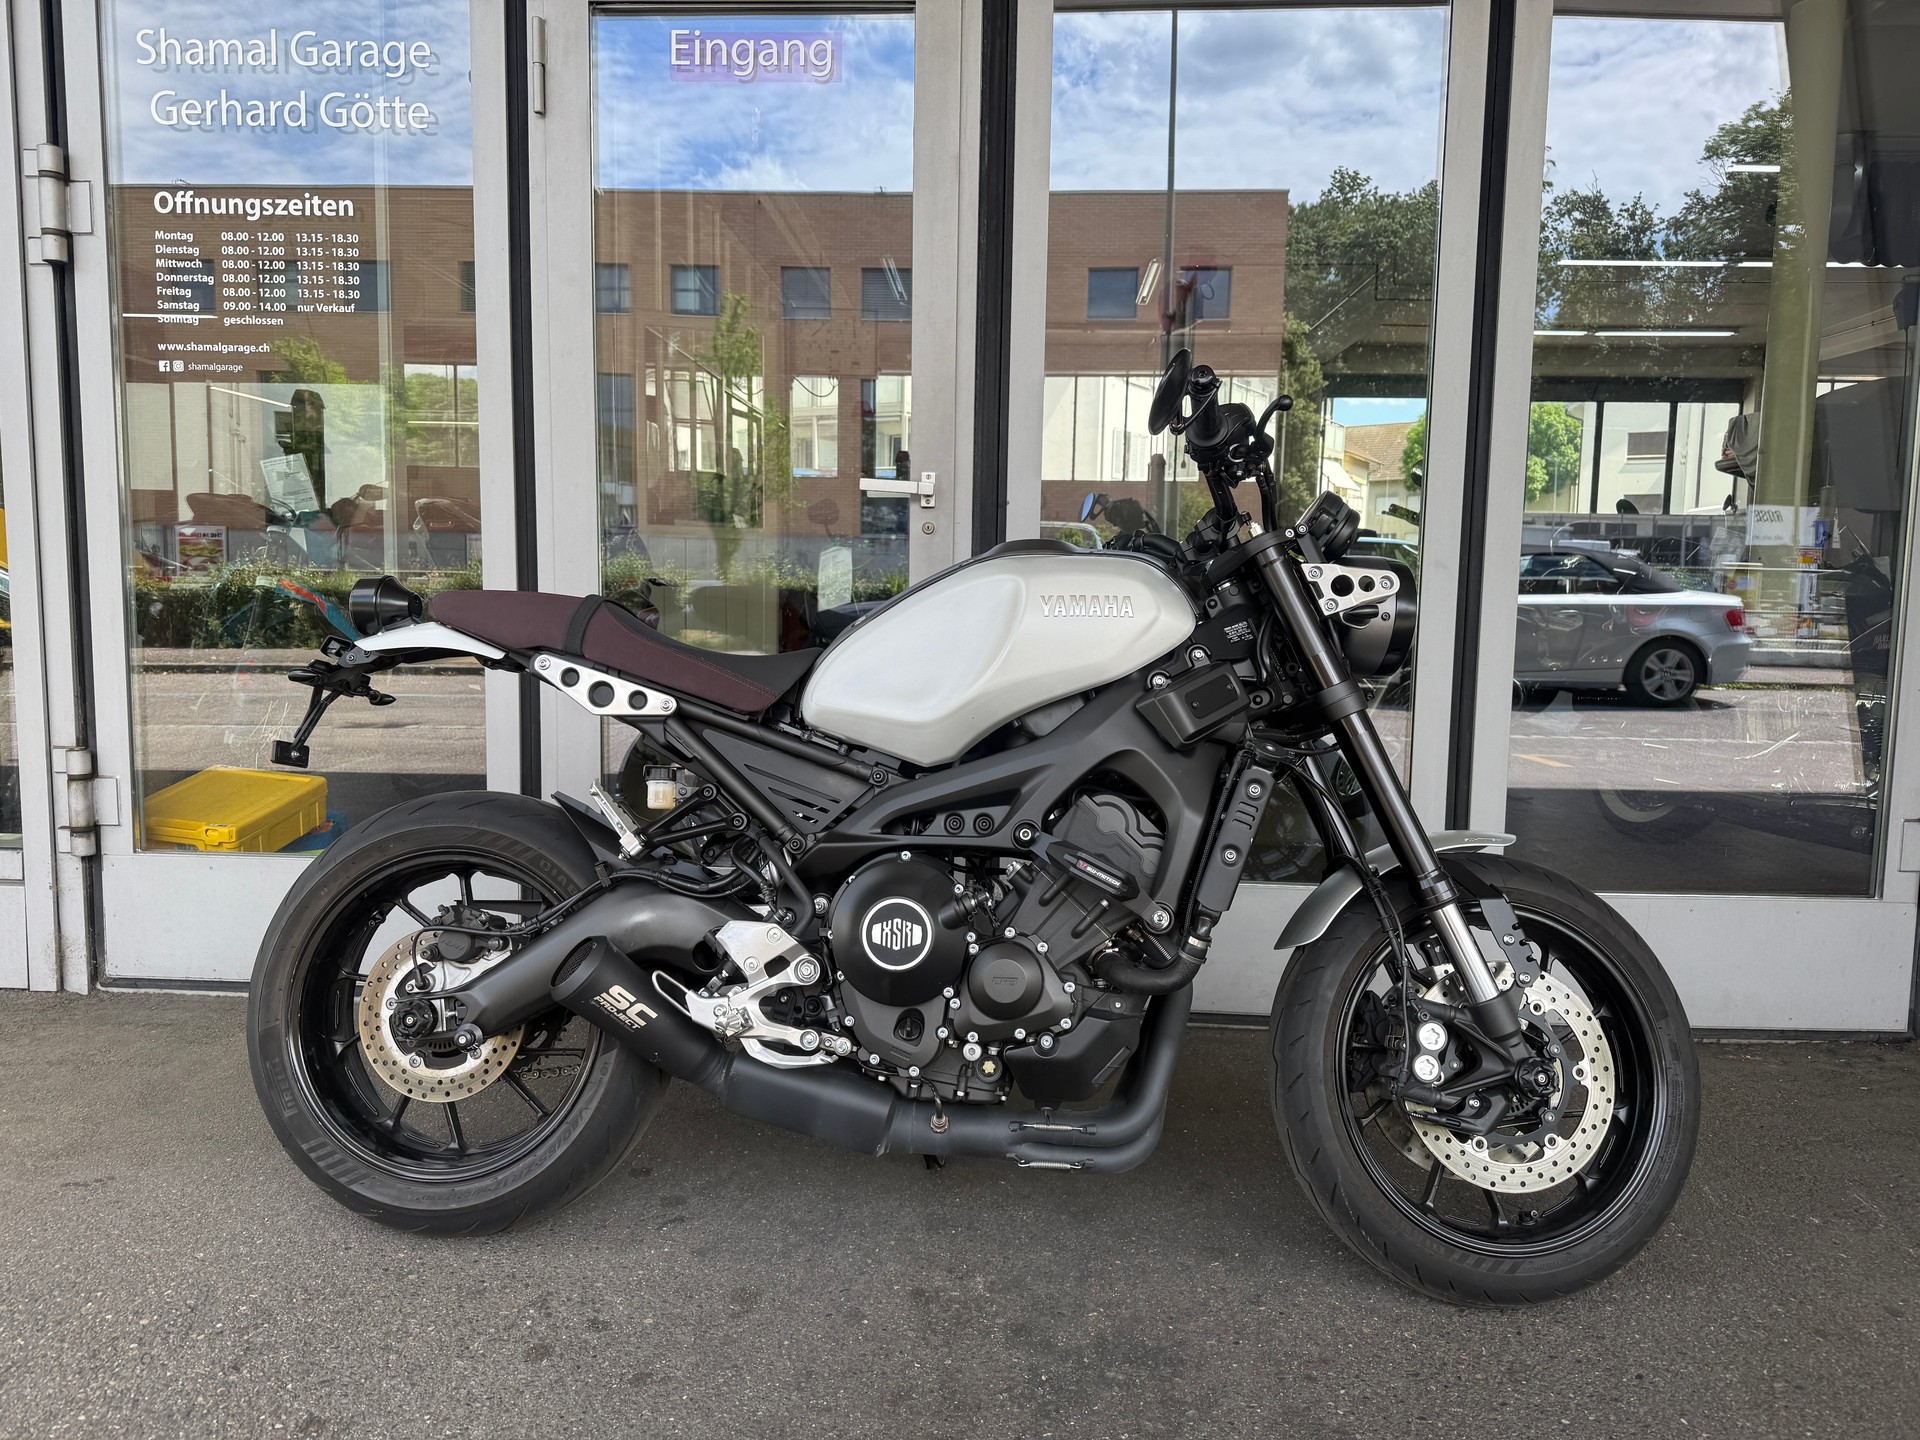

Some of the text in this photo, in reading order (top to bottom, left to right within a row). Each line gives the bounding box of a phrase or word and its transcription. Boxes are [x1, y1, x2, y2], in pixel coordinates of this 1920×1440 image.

[136, 28, 431, 78] Shamal Garage
[670, 29, 833, 77] Eingang
[150, 89, 430, 129] Gerhard Götte
[155, 231, 194, 243] Montag
[220, 232, 249, 242] 08.00
[257, 232, 285, 242] 12.00
[296, 233, 323, 243] 13.15
[332, 234, 359, 244] 18.30
[155, 245, 200, 256] Dienstag
[221, 246, 249, 256] 08.00
[257, 246, 285, 256] 12.00
[296, 247, 323, 257] 13.15
[332, 248, 359, 258] 18.30
[156, 259, 203, 269] Mittwoch
[221, 260, 250, 270] 08.00
[258, 260, 286, 270] 12.00
[296, 261, 324, 271] 13.15
[332, 262, 360, 272] 18.30
[156, 273, 215, 285] Donnerstag
[222, 274, 250, 284] 08.00
[258, 274, 286, 284] 12.00
[297, 275, 324, 285] 13.15
[333, 276, 360, 286] 18.30
[157, 286, 192, 297] Freitag
[222, 288, 251, 298] 08.00
[259, 288, 287, 298] 12.00
[297, 289, 325, 299] 13.15
[333, 290, 361, 300] 18.30
[157, 300, 200, 312] Samstag
[223, 302, 251, 312] 09.00
[259, 302, 287, 312] 14.00
[297, 304, 314, 312] nur
[315, 303, 355, 313] Verkauf
[223, 315, 284, 327] geschlossen
[157, 341, 270, 354] www.shamalgarage.ch
[188, 362, 243, 373] shamalgarage
[1040, 594, 1134, 618] YAMAHA
[882, 917, 912, 951] XSR
[593, 995, 641, 1029] PROJECT
[600, 984, 659, 1027] SC
